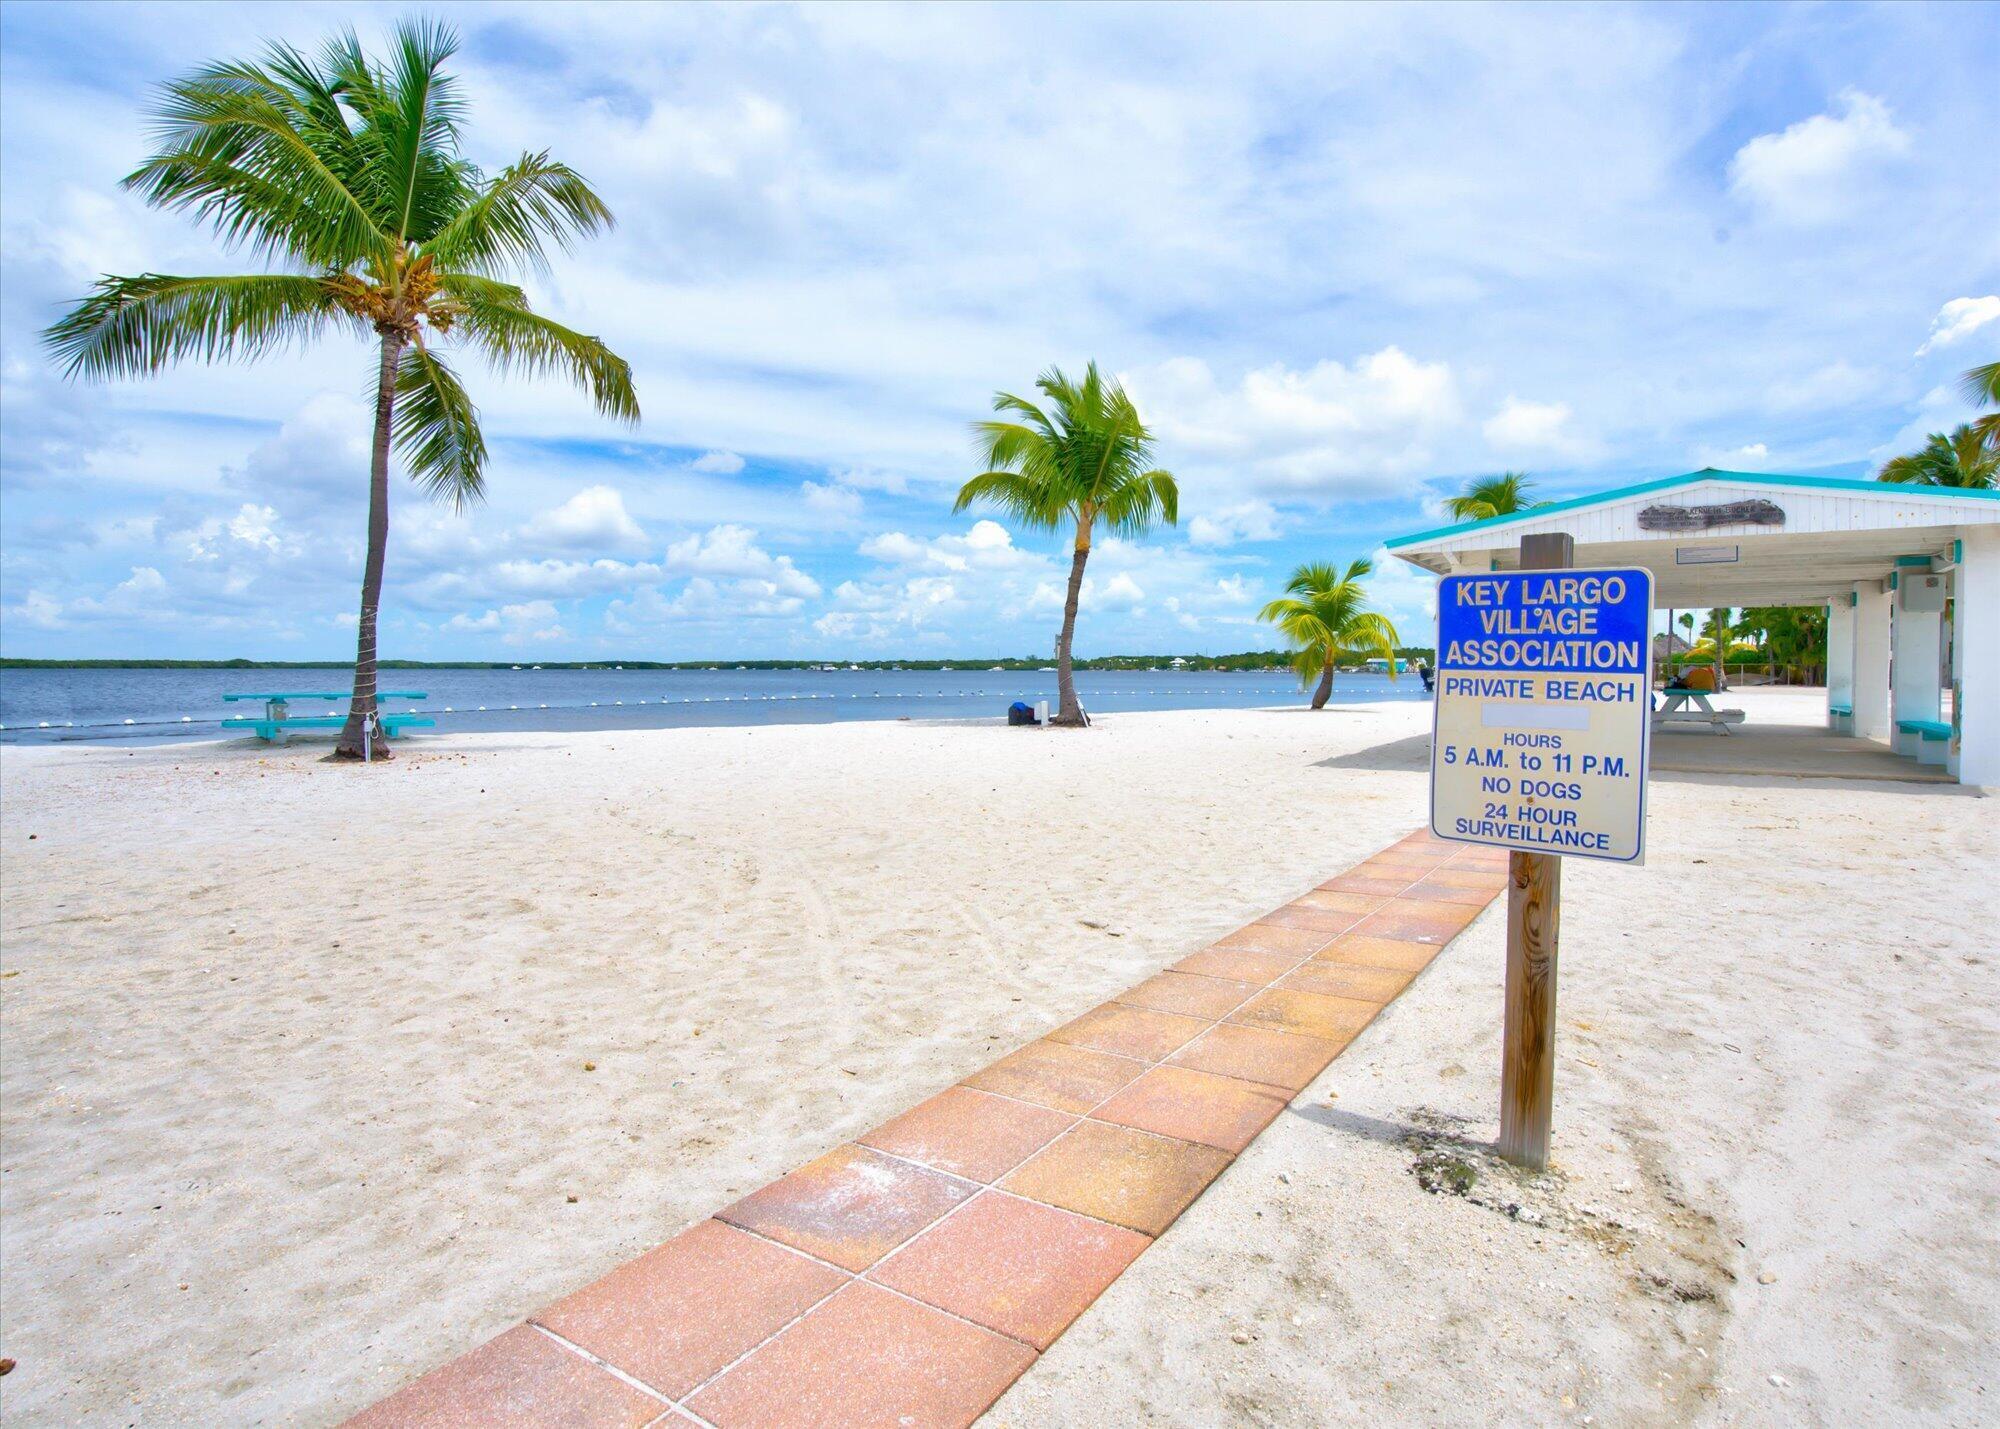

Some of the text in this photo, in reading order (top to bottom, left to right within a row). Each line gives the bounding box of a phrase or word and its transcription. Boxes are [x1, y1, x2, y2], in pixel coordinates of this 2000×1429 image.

[1457, 577, 1626, 606] KEY LARGO
[1480, 608, 1598, 635] VILLAGE
[1446, 640, 1639, 668] ASSOCIATION
[1446, 678, 1634, 702] PRIVATE BEACH
[1503, 733, 1562, 748] HOURS
[1444, 746, 1630, 777] 5 A.M. to 11 P.M.
[1482, 776, 1582, 800] NO DOGS
[1484, 803, 1577, 827] 24 HOUR
[1456, 818, 1610, 850] SURVEILLANCE
